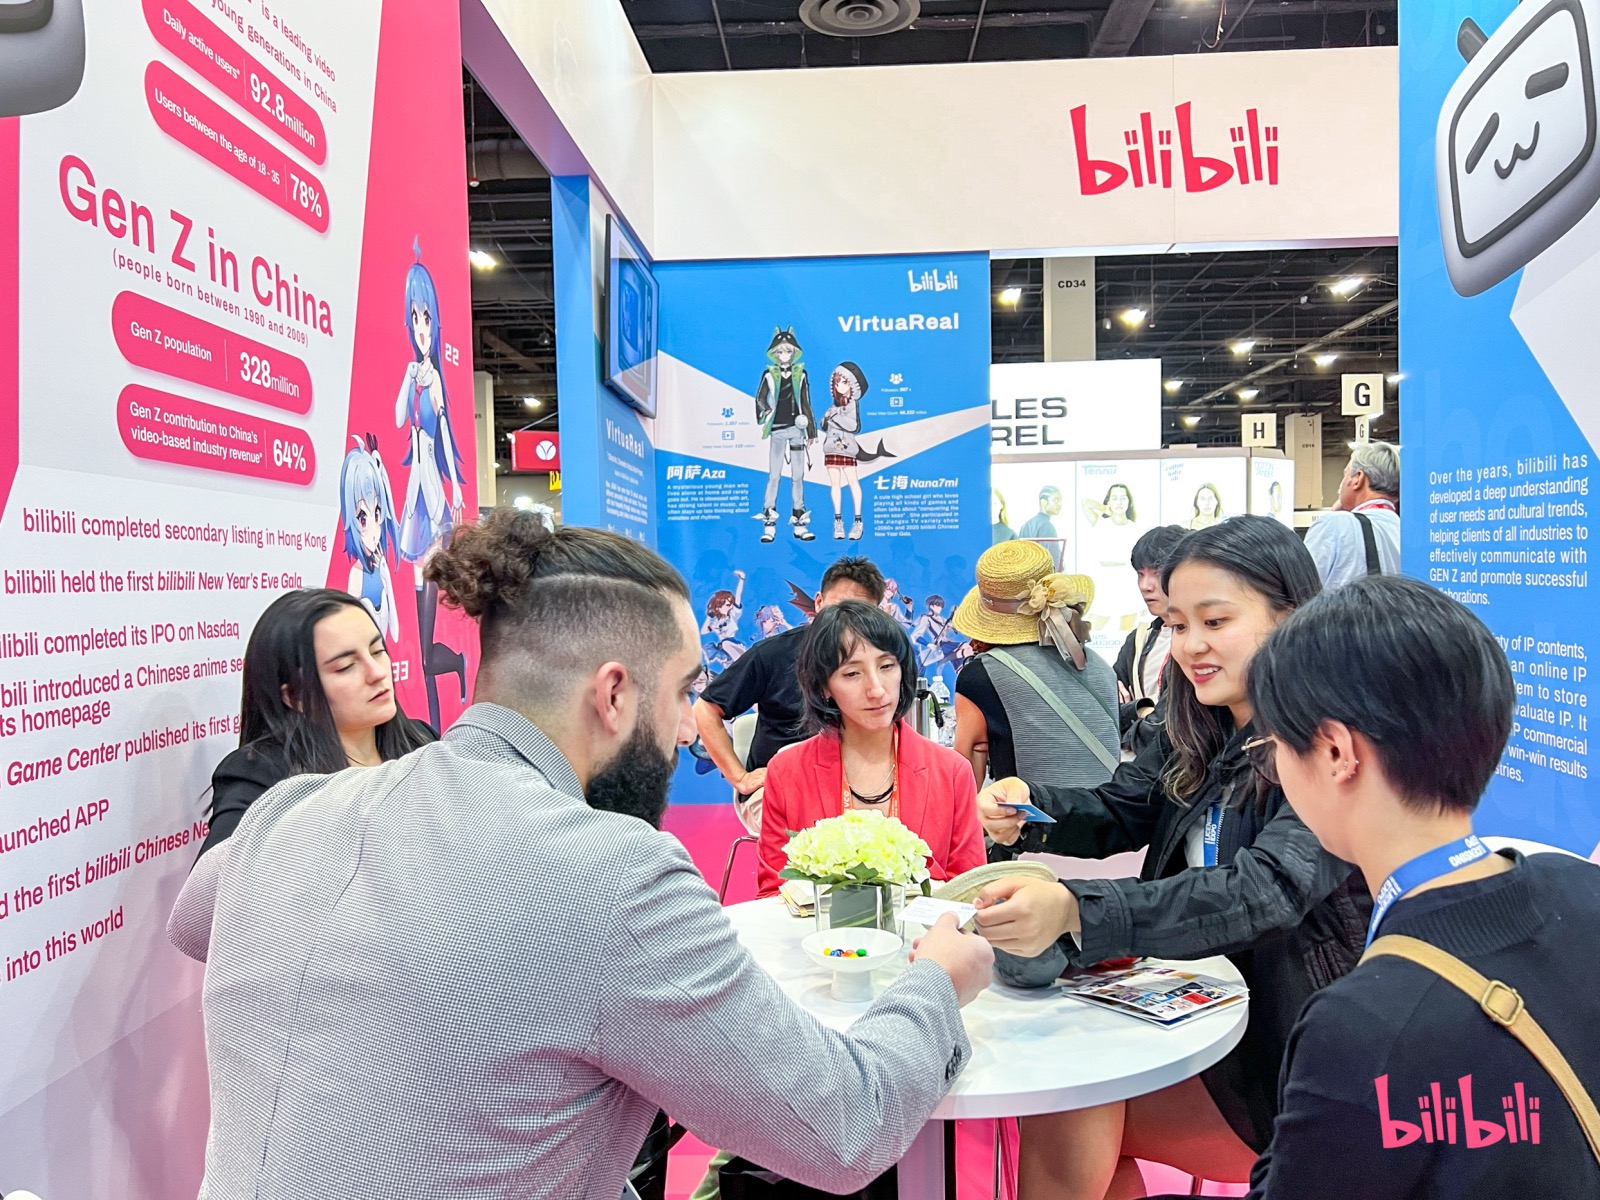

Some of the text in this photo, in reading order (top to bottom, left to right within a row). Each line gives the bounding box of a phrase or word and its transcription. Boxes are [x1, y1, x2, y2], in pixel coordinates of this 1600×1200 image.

[163, 8, 187, 40] Daily
[188, 31, 214, 60] active
[261, 0, 336, 82] is a leading video
[247, 25, 301, 81] generations
[304, 71, 312, 91] in
[314, 82, 337, 114] China
[154, 88, 280, 185] Users between the age of 18 35
[1070, 101, 1278, 195] bilibili
[290, 173, 322, 218] 78%
[59, 154, 334, 337] Gen Z in China
[908, 269, 958, 293] bilibili
[1057, 279, 1087, 289] CD34
[112, 247, 309, 349] (people born between 1990 and 2009)
[838, 313, 959, 332] VirtuaReal
[130, 321, 212, 362] Gen Z population
[445, 342, 459, 367] 22
[992, 397, 1068, 419] LES
[1354, 382, 1371, 407] G
[129, 401, 258, 444] Gen Z contribution to China's
[606, 418, 644, 458] VirtuaReal
[1253, 422, 1265, 438] H
[1360, 424, 1364, 438] G
[131, 425, 191, 450] video-based
[193, 437, 228, 460] industry
[272, 439, 307, 472] 64%
[667, 465, 726, 480] 阿萨 Aza
[874, 475, 908, 490] 七海
[1430, 453, 1587, 485] Over the years, bilibili has
[1430, 476, 1588, 505] developed a deep understanding
[1430, 500, 1587, 523] of user needs and cultural trends,
[23, 507, 327, 551] bilibili completed secondary listing in Hong Kong
[1430, 524, 1588, 545] helping clients of all industries to
[1430, 547, 1587, 565] effectively communicate with
[4, 570, 302, 594] bilibili held the first bilibili New Year's Eve Gala
[1430, 568, 1587, 587] GEN Z and promote successful
[44, 625, 126, 656] completed
[131, 626, 147, 646] its
[151, 623, 175, 644] IPO
[178, 625, 194, 641] on
[197, 619, 240, 640] Nasdaq
[1511, 635, 1587, 662] of IP contents,
[33, 669, 120, 703] introduced
[124, 673, 133, 689] a
[137, 664, 190, 687] Chinese
[193, 658, 228, 679] anime
[1511, 660, 1587, 683] an online IP
[1538, 684, 1587, 707] to store
[22, 700, 111, 733] homepage
[1512, 703, 1587, 731] valuate IP. It
[7, 756, 62, 786] Game
[67, 742, 121, 771] Center
[125, 723, 190, 762] published
[192, 719, 206, 739] its
[209, 714, 231, 736] first
[1524, 727, 1587, 755] commercial
[1508, 745, 1587, 779] win-win results
[75, 798, 110, 830] APP
[14, 887, 44, 913] the
[48, 868, 81, 900] first
[84, 846, 131, 885] bilibili
[134, 829, 190, 864] Chinese
[6, 905, 124, 982] into this world
